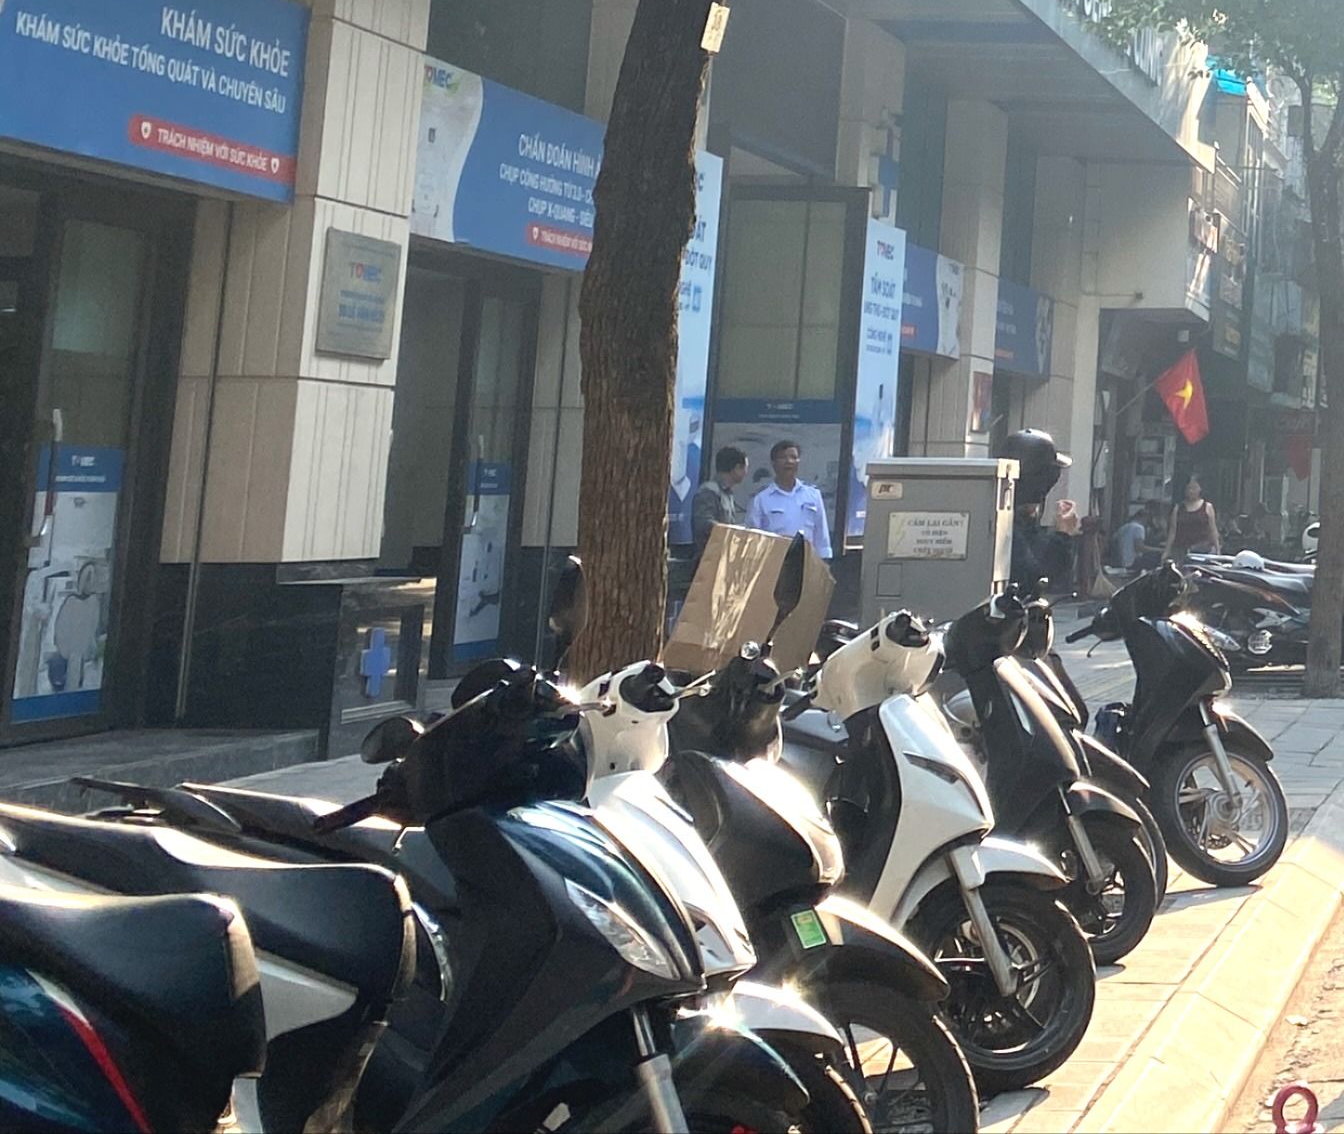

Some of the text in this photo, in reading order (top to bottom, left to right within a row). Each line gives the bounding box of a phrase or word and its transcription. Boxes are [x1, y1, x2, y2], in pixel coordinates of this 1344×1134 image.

[15, 10, 60, 46] KHÁM
[62, 22, 91, 55] SỨC
[93, 33, 130, 66] KHỎE
[167, 57, 200, 87] QUÁT
[200, 66, 217, 94] VÀ
[218, 74, 263, 109] CHUYÊN
[263, 88, 287, 115] SÂU
[160, 6, 291, 78] KHÁM SỨC KHỎE
[157, 127, 187, 149] TRÁCH
